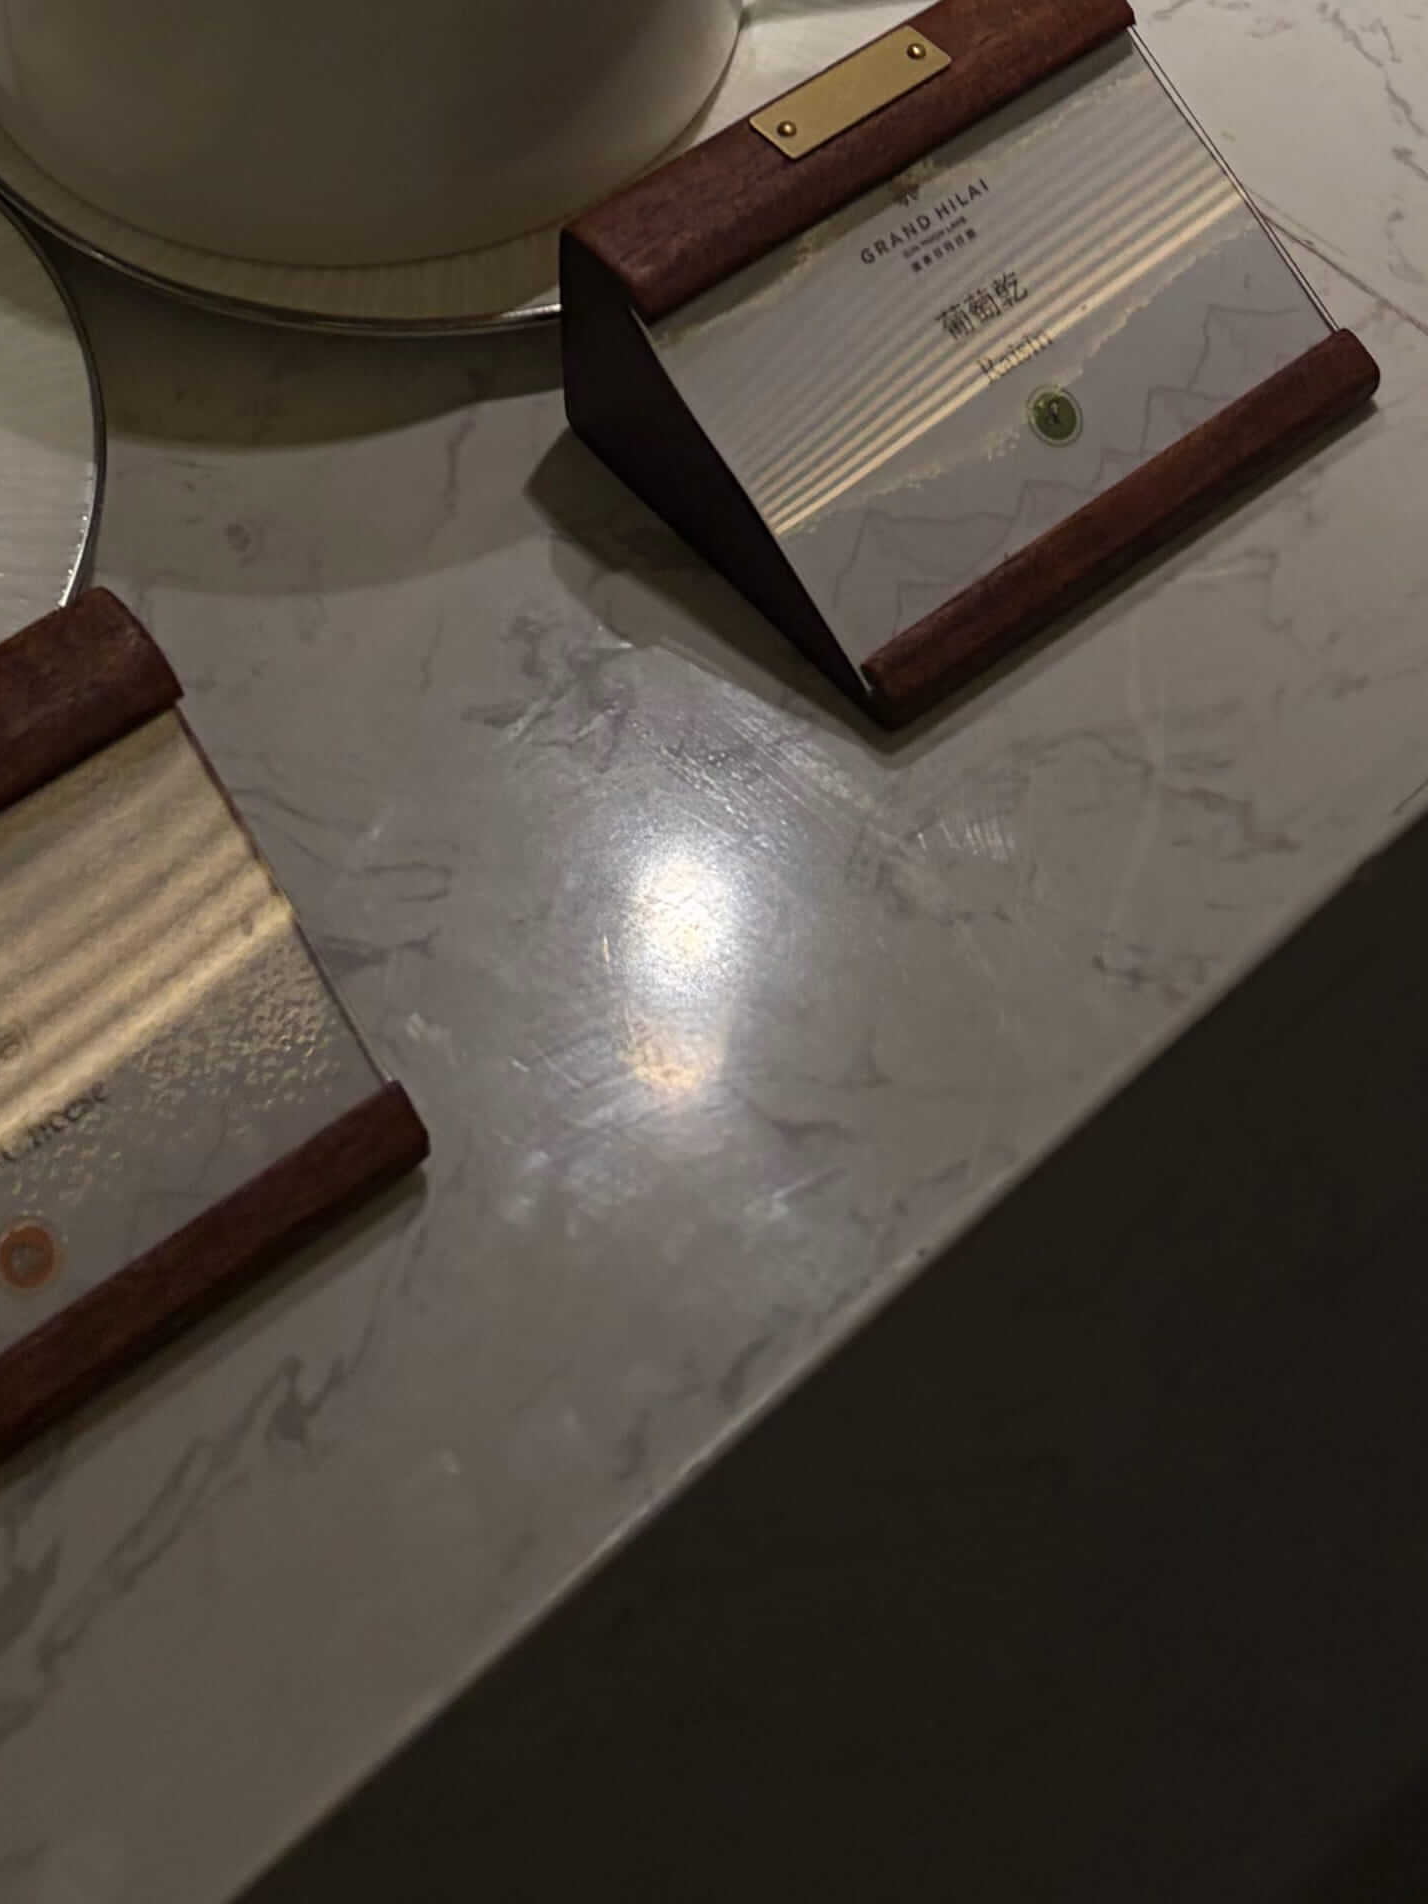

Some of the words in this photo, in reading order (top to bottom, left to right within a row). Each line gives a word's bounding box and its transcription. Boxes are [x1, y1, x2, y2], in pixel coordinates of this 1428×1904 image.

[861, 214, 931, 264] GRAND
[934, 178, 989, 221] HILAI
[935, 271, 1029, 341] 葡萄乾
